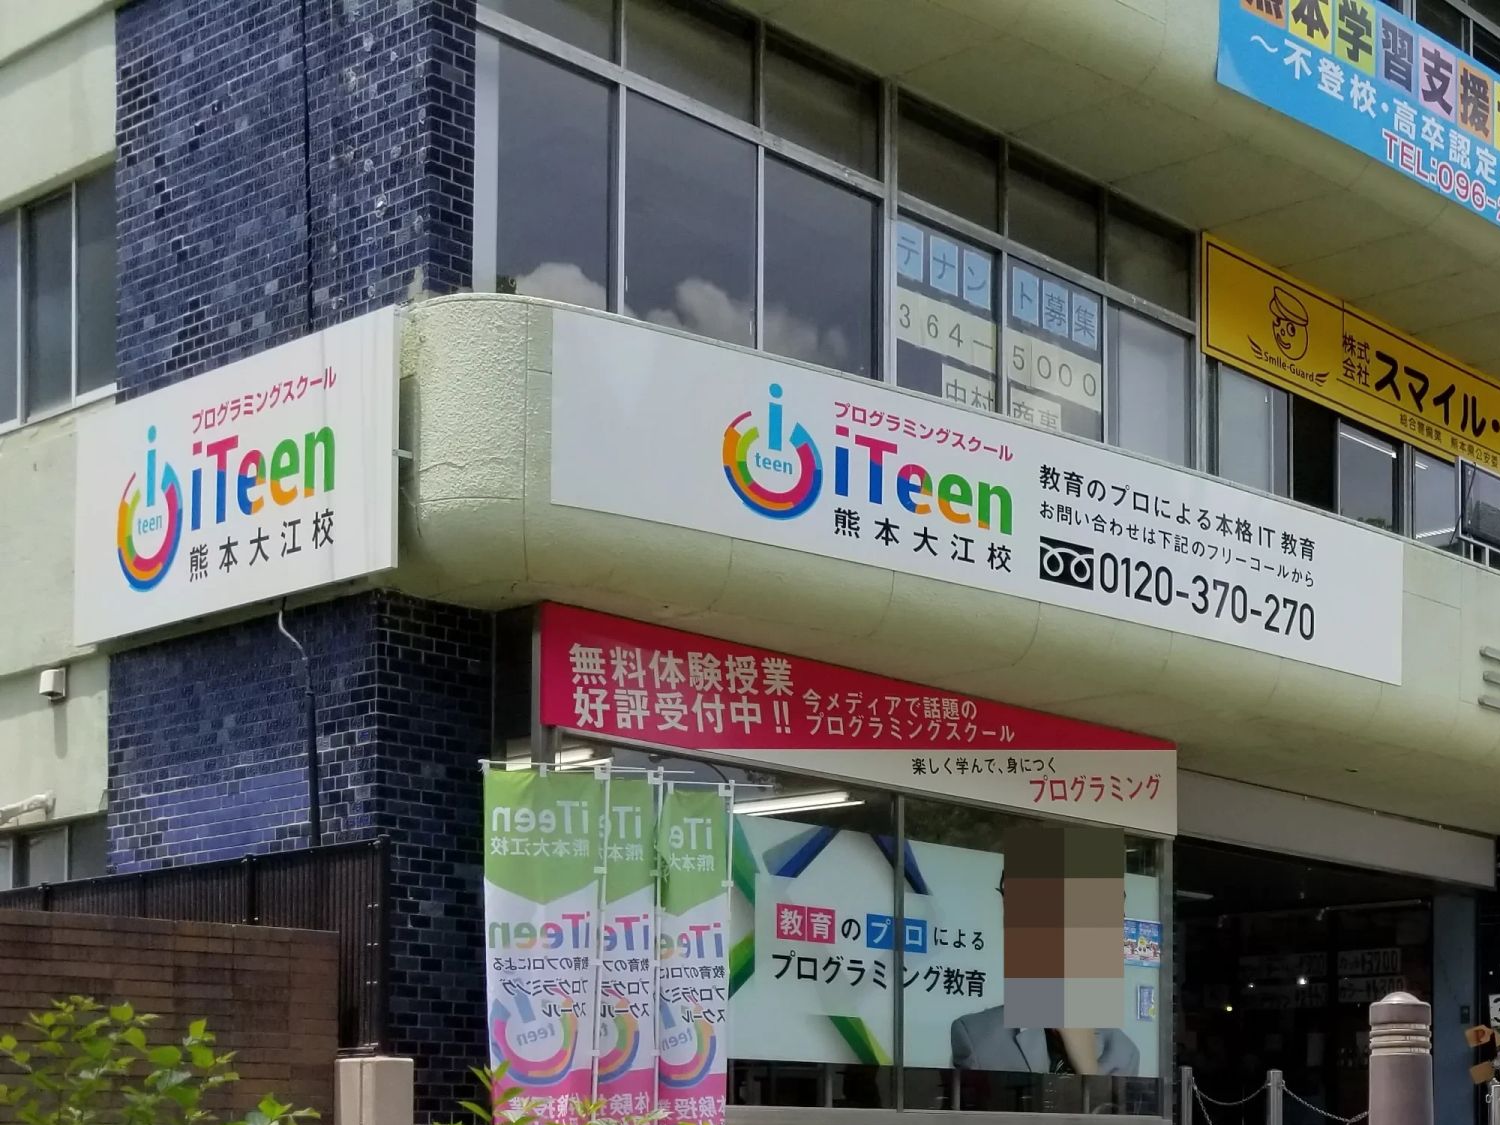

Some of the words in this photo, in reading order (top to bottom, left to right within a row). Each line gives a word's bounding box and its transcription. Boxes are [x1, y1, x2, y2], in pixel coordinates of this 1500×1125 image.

[897, 237, 1095, 338] テナント募集
[1342, 333, 1370, 364] 株式
[1343, 357, 1370, 388] 会社
[192, 366, 337, 434] プログラミングスクール
[834, 401, 1013, 462] プログラミングスクール
[191, 426, 335, 531] iTeen
[754, 452, 793, 475] teen
[834, 425, 1012, 535] iTeen
[137, 513, 162, 536] teen
[189, 508, 335, 582] 熊本大江校
[834, 507, 1012, 573] 熊本大江校
[1039, 501, 1314, 588] お問い合わせは下記のフリーコールから
[1100, 552, 1315, 641] 0120-370-270
[569, 643, 794, 697] 無料体験授業
[572, 687, 791, 735] 好評受付中!!
[802, 688, 977, 720] 今メディアで話題の
[806, 712, 1015, 744] プログラミングスクール
[911, 756, 1057, 776] 楽しく学んで、身につく
[1029, 773, 1162, 803] プログラミング
[778, 906, 985, 951] 教育のプロによる
[771, 951, 987, 998] プログラミング教育
